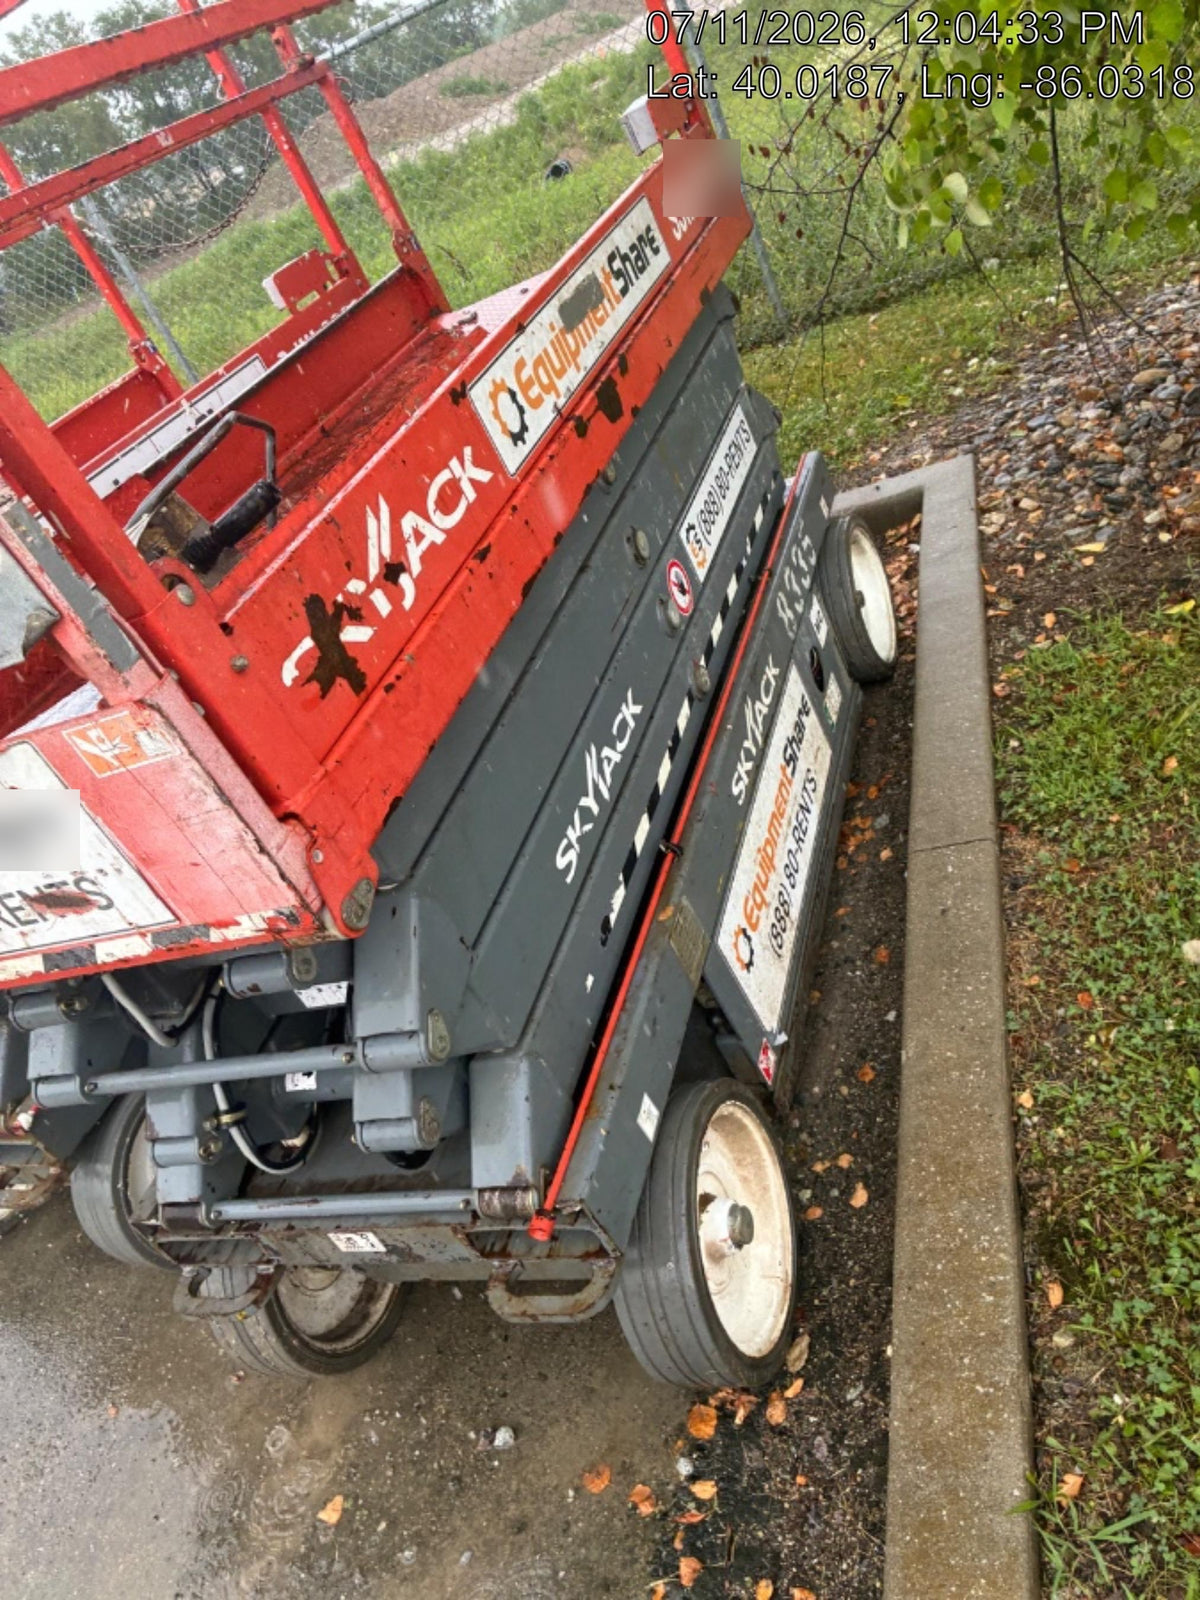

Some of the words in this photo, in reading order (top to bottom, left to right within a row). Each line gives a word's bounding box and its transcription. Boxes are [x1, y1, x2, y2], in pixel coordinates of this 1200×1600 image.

[697, 484, 724, 546] (888)
[555, 687, 643, 885] SKYJACK
[732, 653, 780, 806] SKYJACK
[743, 693, 811, 933] EquipmentShare
[769, 882, 792, 959] (888)
[783, 772, 817, 890] 80-RENTS
